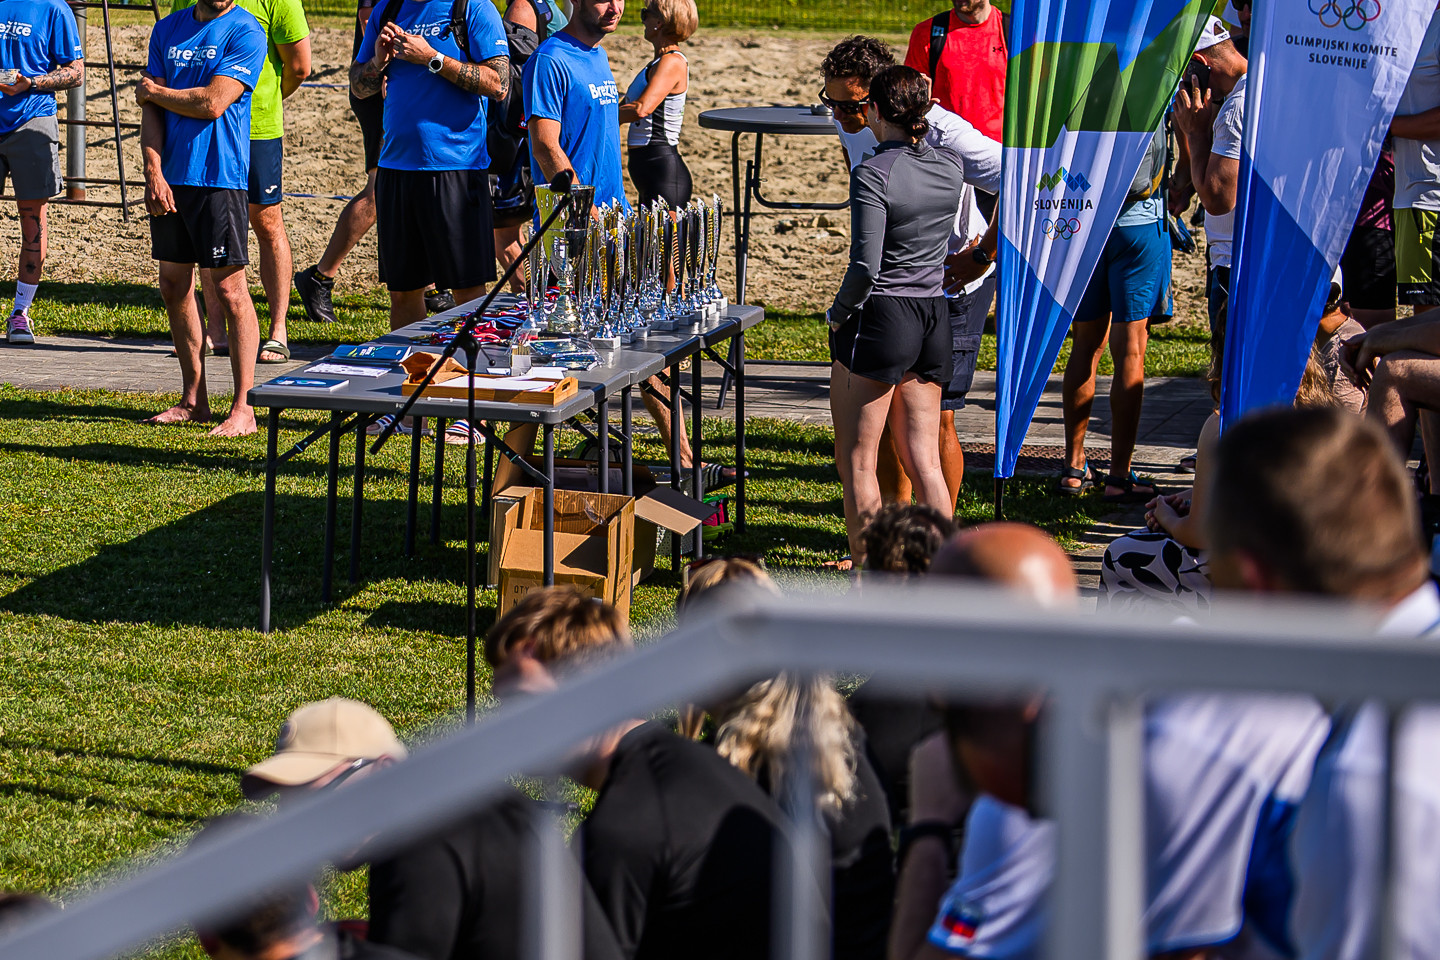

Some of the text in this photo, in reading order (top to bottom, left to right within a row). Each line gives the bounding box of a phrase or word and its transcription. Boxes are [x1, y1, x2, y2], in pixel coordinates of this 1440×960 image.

[405, 24, 441, 37] ežice
[1285, 34, 1398, 57] OLIMPIJSKI KOMITE
[1309, 52, 1368, 69] SLOVENIJE
[1034, 198, 1093, 211] SLOVENIJA
